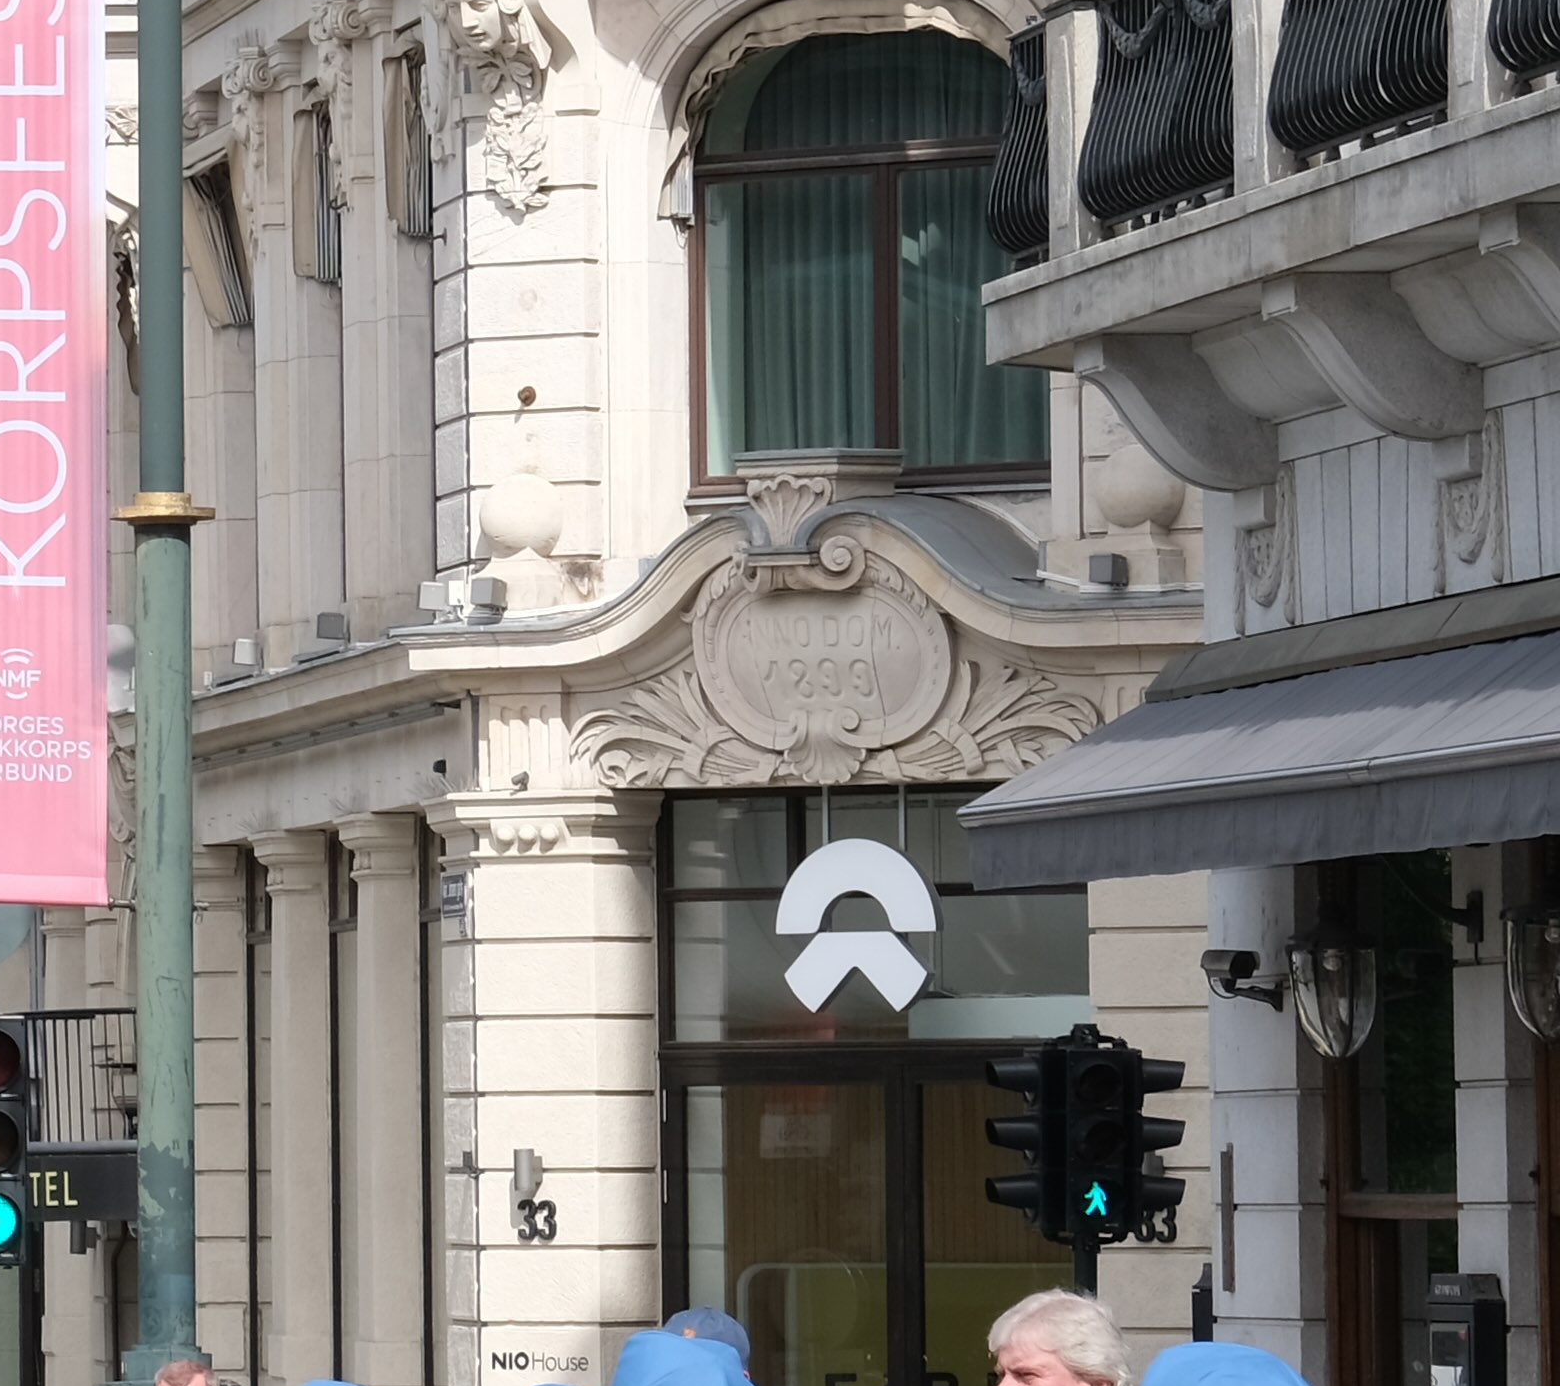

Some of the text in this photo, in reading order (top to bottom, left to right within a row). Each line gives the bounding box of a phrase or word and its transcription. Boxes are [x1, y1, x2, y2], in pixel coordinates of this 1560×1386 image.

[29, 1171, 79, 1207] TEL
[517, 1199, 557, 1241] 33
[492, 1351, 589, 1372] NIO House
